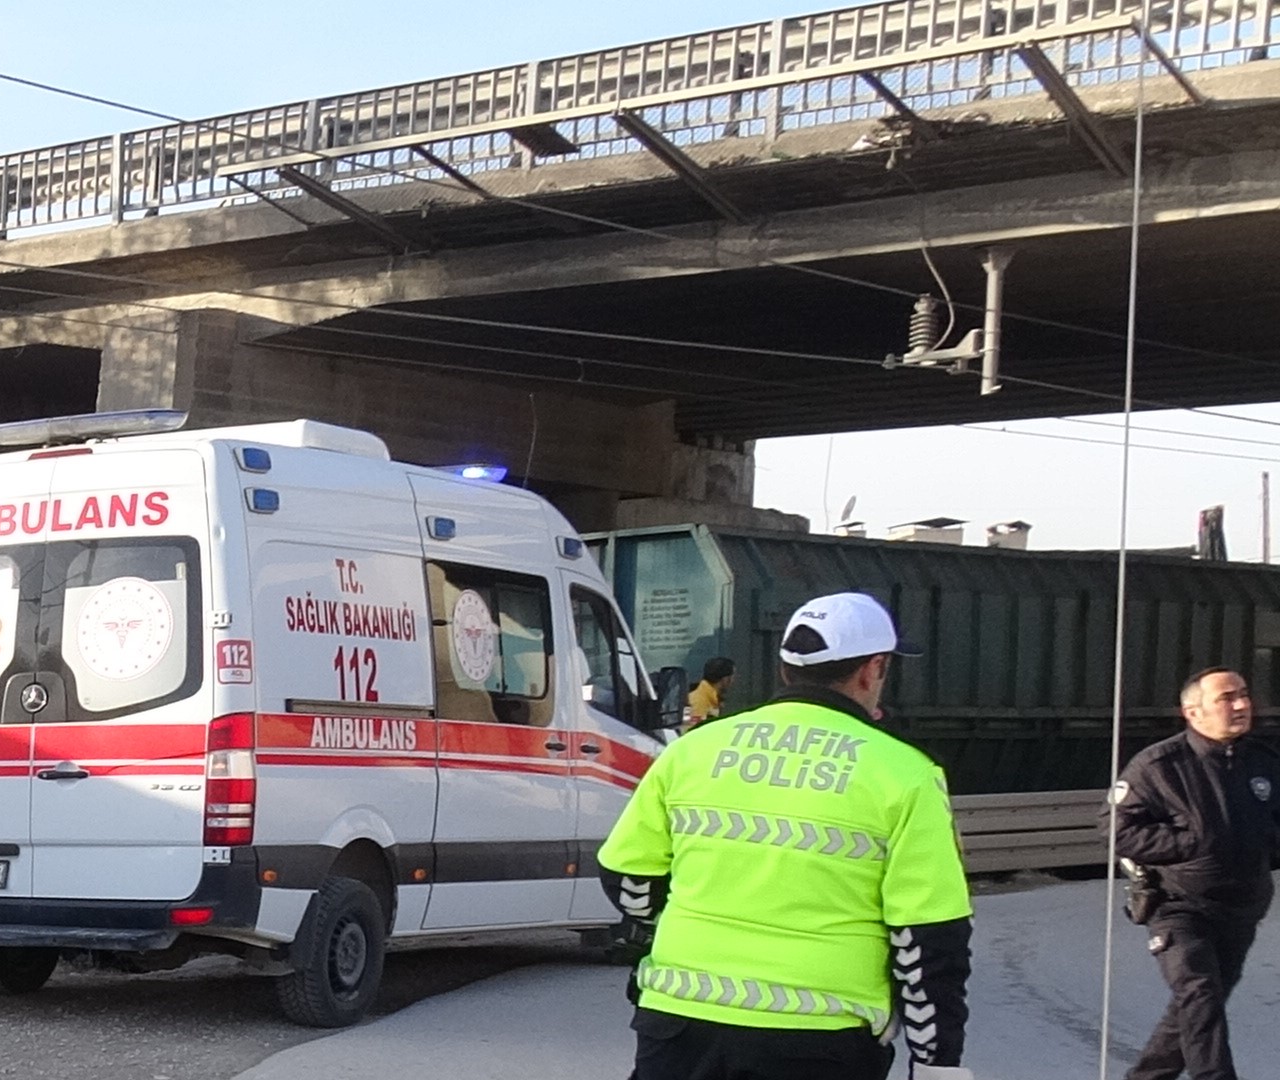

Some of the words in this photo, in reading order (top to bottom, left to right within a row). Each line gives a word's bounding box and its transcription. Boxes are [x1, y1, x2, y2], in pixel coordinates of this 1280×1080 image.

[335, 558, 364, 594] T.C.
[286, 591, 340, 635] SAĞLIK
[343, 601, 417, 642] BAKANLIĞI
[222, 645, 250, 665] 112
[334, 645, 379, 703] 112
[310, 717, 417, 750] AMBULANS
